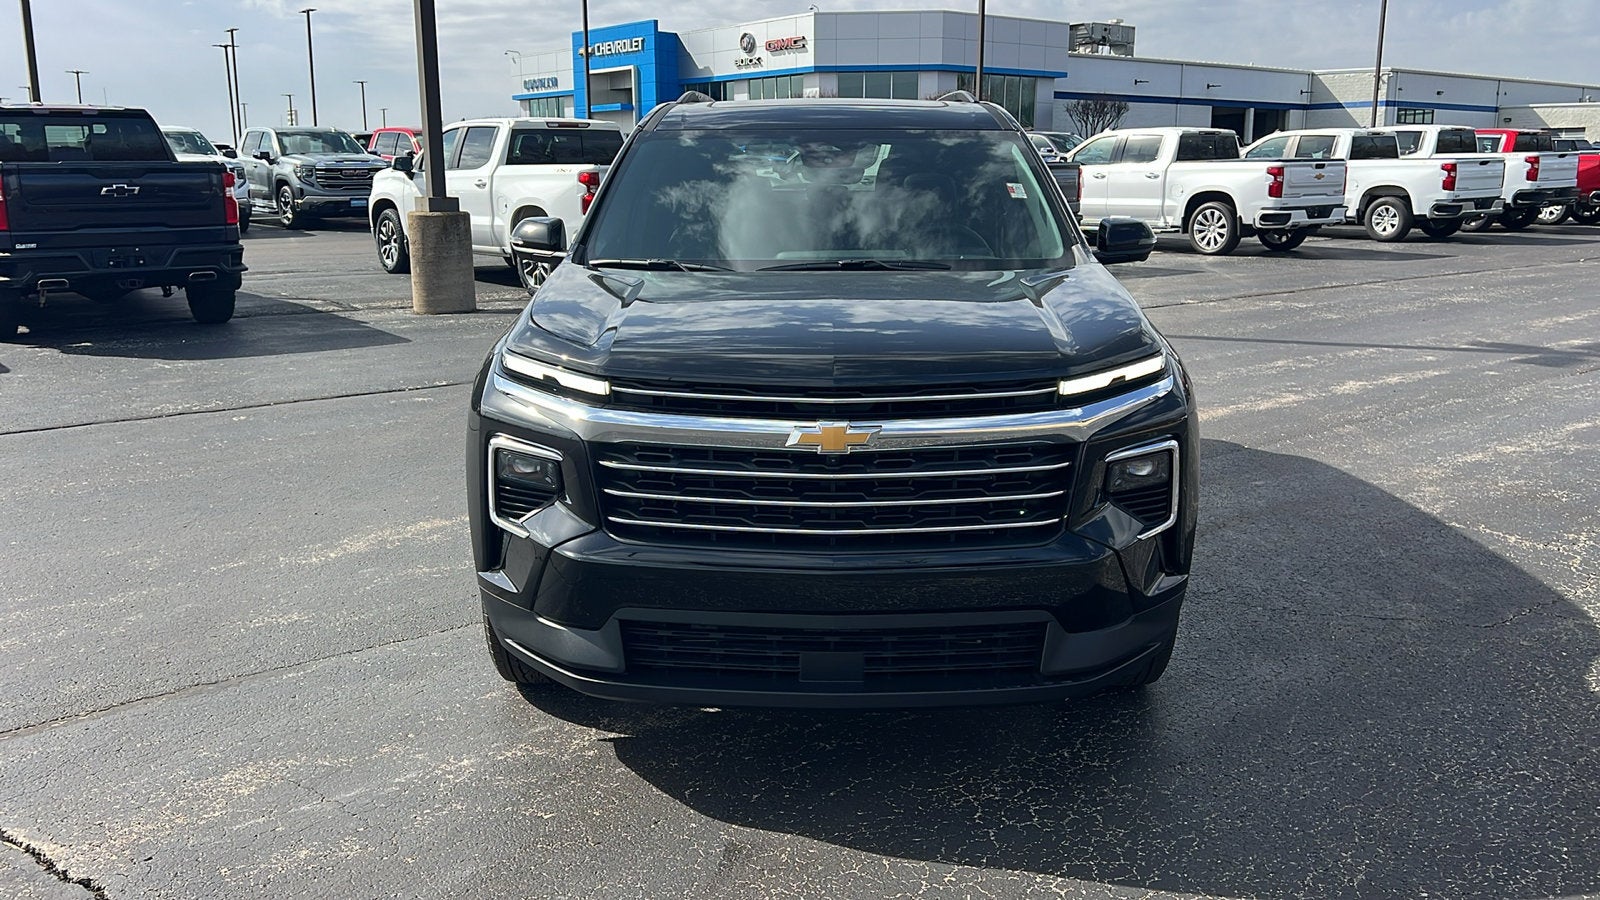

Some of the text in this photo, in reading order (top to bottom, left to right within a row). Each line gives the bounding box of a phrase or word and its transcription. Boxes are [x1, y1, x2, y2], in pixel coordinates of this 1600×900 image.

[594, 37, 645, 56] CHEVROLET
[765, 36, 805, 52] GMC
[735, 57, 763, 67] BUICK
